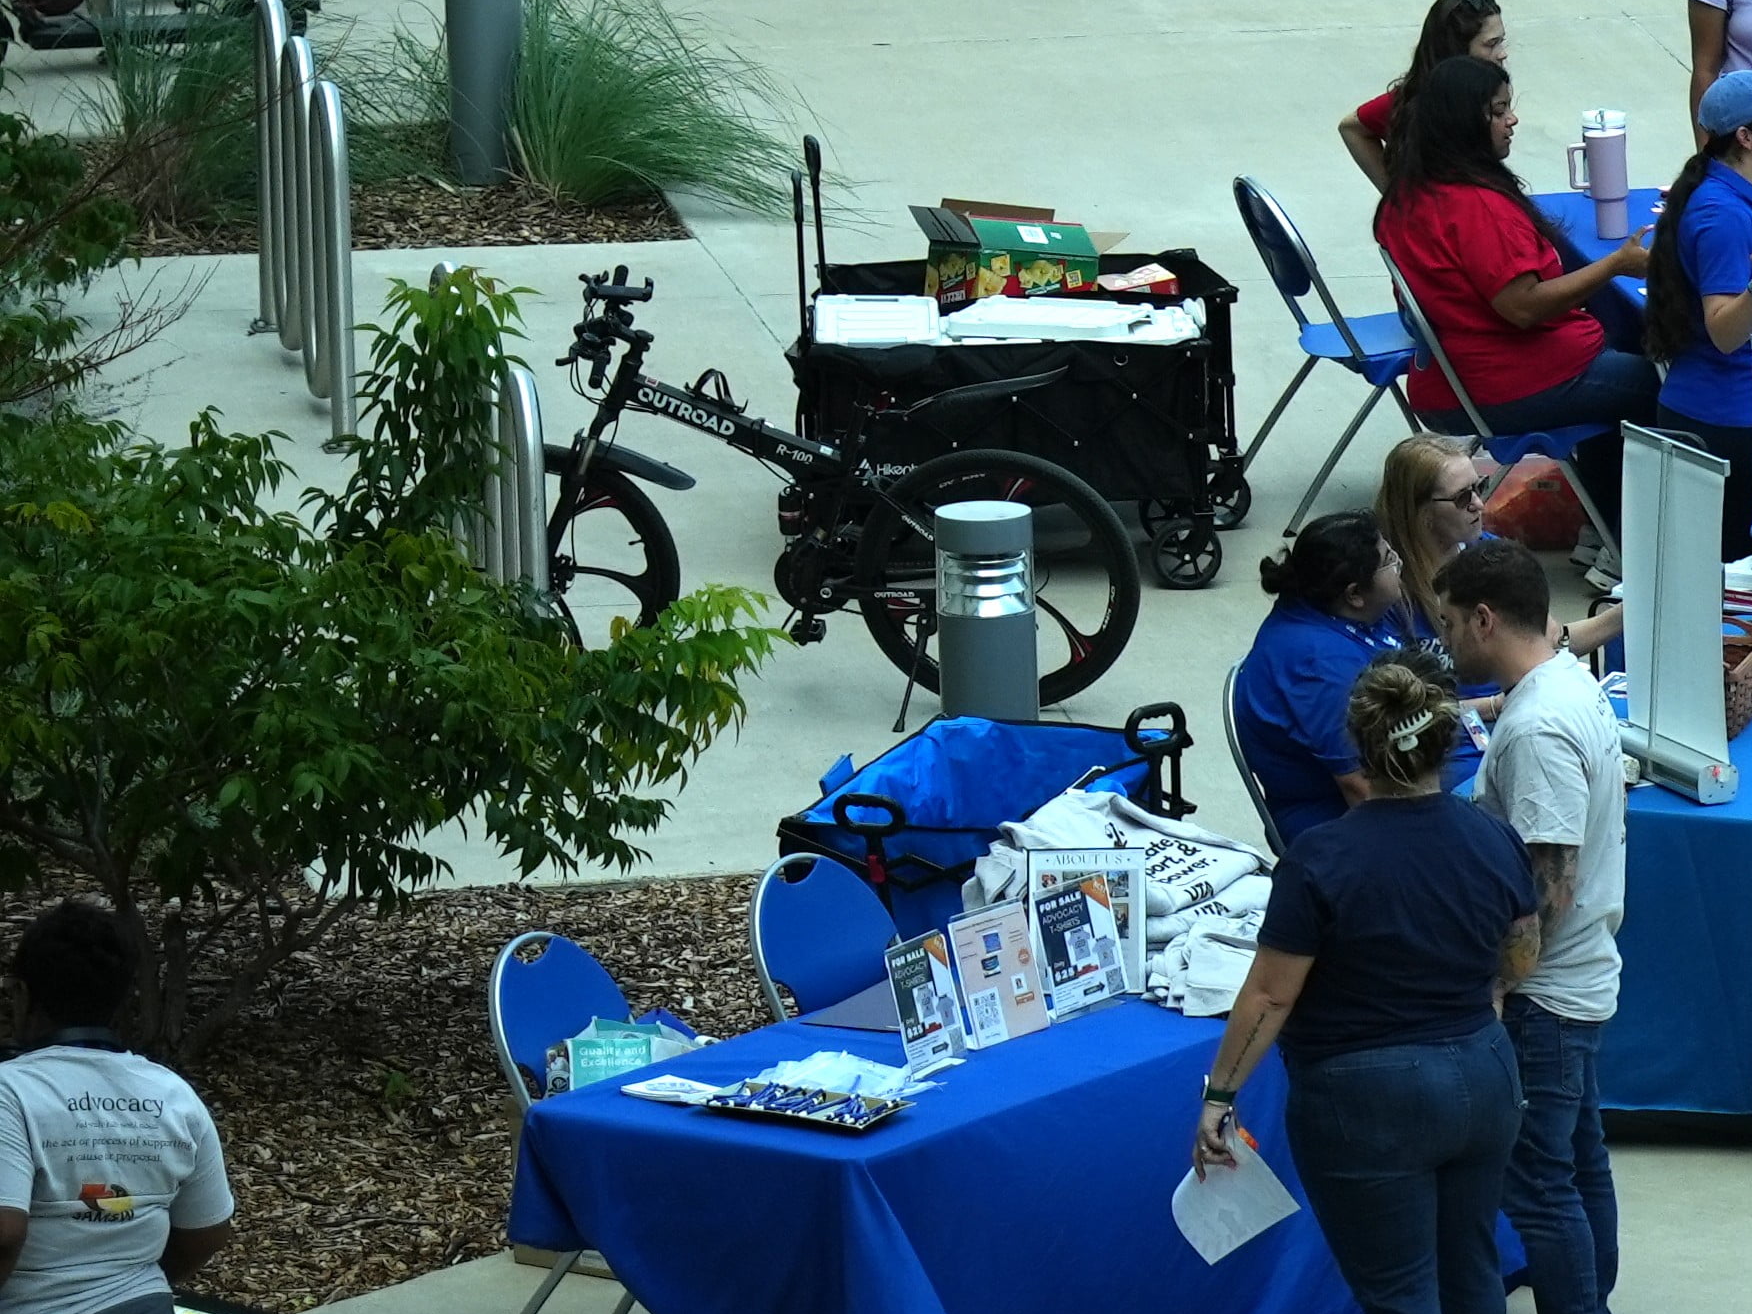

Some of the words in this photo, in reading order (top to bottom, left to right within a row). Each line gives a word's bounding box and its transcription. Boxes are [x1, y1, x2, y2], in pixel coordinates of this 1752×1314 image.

[637, 386, 735, 436] OUTROAD
[775, 443, 814, 464] R-100
[1052, 853, 1099, 865] ABOUT
[1103, 854, 1123, 865] US
[1145, 838, 1174, 860] ate
[1145, 855, 1186, 878] port,
[1174, 840, 1201, 856] &
[1156, 858, 1219, 884] power.
[1039, 898, 1057, 914] FOR
[1058, 890, 1082, 906] SALE
[1184, 881, 1214, 902] UTA
[1042, 903, 1084, 925] ADVOCACY
[1049, 916, 1081, 934] T-SHIRTS
[891, 955, 906, 968] FOR
[906, 948, 925, 961] SALE
[579, 1045, 621, 1057] Quality
[623, 1045, 646, 1055] and
[580, 1056, 646, 1068] Excellence.
[67, 1091, 164, 1118] advocacy
[42, 1138, 58, 1149] the
[61, 1139, 76, 1147] act
[92, 1138, 127, 1148] process
[143, 1138, 192, 1152] supporting
[76, 1153, 103, 1162] cause
